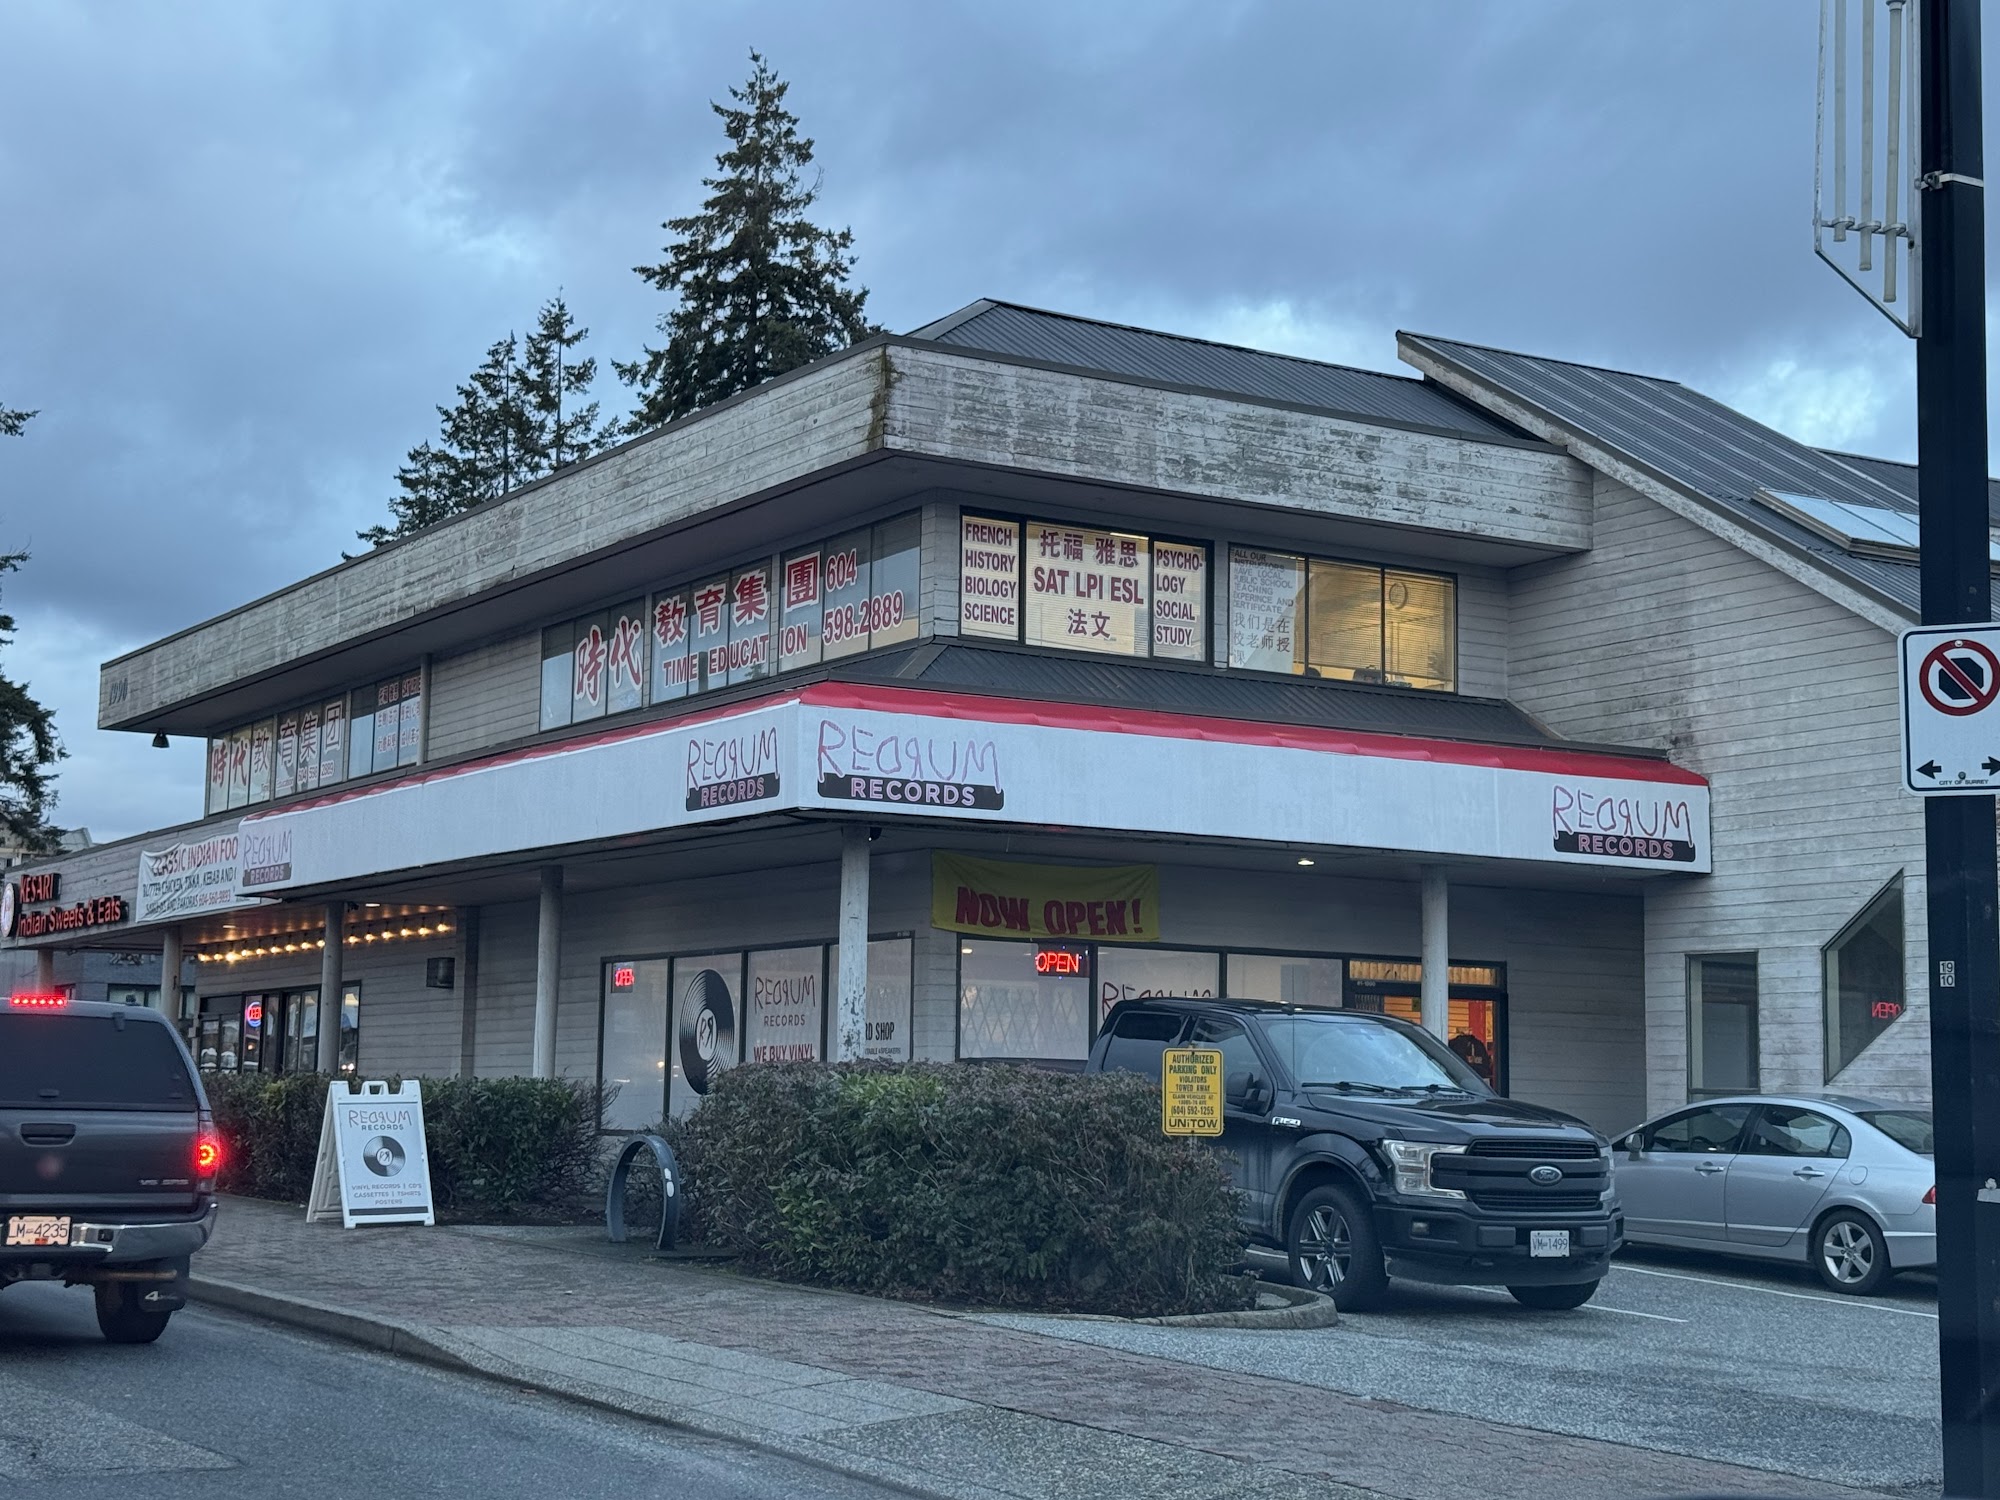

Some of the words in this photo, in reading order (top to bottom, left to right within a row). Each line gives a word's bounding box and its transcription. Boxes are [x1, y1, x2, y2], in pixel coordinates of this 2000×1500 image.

[964, 523, 1013, 546] FRENCH
[1040, 530, 1084, 561] 托福
[1095, 537, 1139, 568] 雅思
[1156, 548, 1204, 571] PSYCHO-
[1234, 549, 1247, 559] ALL
[1250, 551, 1267, 562] OUR
[826, 549, 857, 592] 604
[964, 549, 1016, 573] HISTORY
[1033, 566, 1069, 596] SAT
[1075, 572, 1104, 600] LPI
[1110, 577, 1144, 605] ESL
[1156, 574, 1185, 595] LOGY
[1257, 569, 1284, 581] LOCAL
[1260, 577, 1293, 589] SCHOOL
[964, 575, 1017, 599] BIOLOGY
[1155, 599, 1197, 622] SOCIAL
[1276, 597, 1294, 607] AND
[823, 590, 904, 645] 598.2889
[964, 602, 1015, 626] SCIENCE
[1067, 608, 1111, 639] 法文
[1155, 625, 1193, 646] STUDY
[663, 656, 698, 687] TIME
[700, 777, 764, 807] RECORDS
[851, 777, 975, 806] RECORDS
[1578, 834, 1674, 859] RECORDS
[250, 865, 285, 885] RECORDS
[20, 874, 54, 904] KESARI
[16, 911, 46, 938] Indian
[48, 905, 84, 932] Sweets
[87, 897, 95, 926] &
[97, 896, 121, 923] Eats
[955, 886, 1031, 932] NOW
[1044, 899, 1144, 935] OPEN!
[1035, 952, 1079, 974] OPEN
[1941, 961, 1954, 973] 19
[1941, 974, 1954, 986] 10
[763, 1014, 806, 1027] RECORDS
[875, 1021, 895, 1041] SHOP
[754, 1045, 768, 1063] WE
[769, 1044, 788, 1062] BUY
[788, 1043, 815, 1061] VINYL
[1172, 1054, 1215, 1065] AUTHORIZED
[1168, 1064, 1198, 1075] PARKING
[1200, 1066, 1218, 1075] ONLY
[1179, 1075, 1207, 1084] VIOLATORS
[1175, 1084, 1193, 1092] TOWED
[1196, 1084, 1211, 1092] AWAY
[1171, 1105, 1186, 1116] (604)
[353, 1191, 389, 1199] CASSETTES
